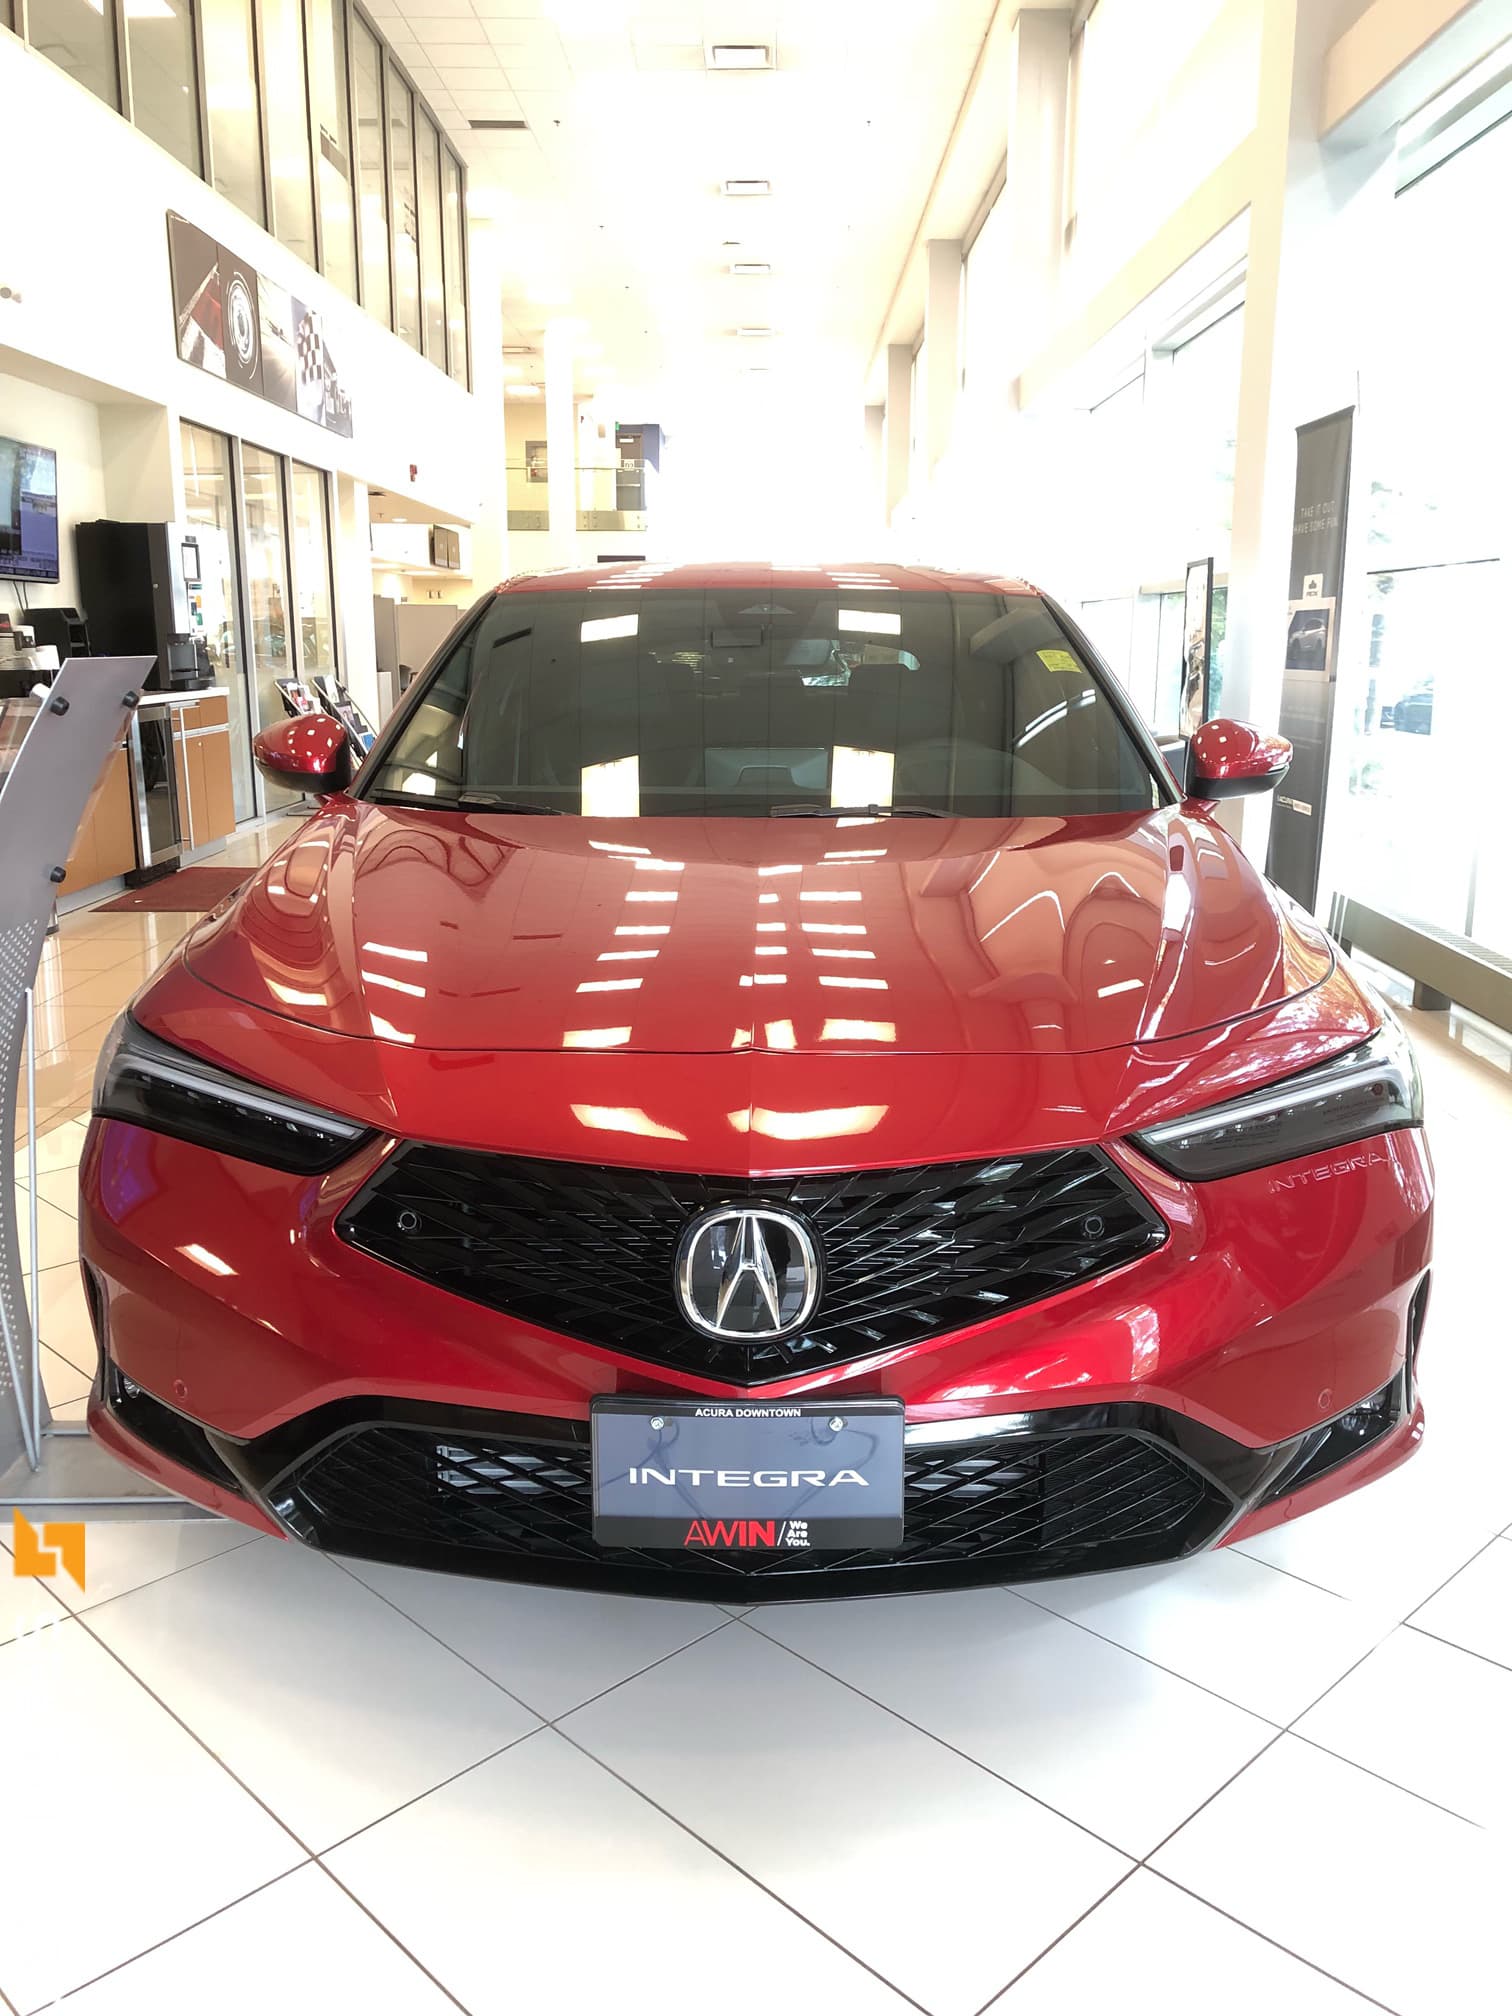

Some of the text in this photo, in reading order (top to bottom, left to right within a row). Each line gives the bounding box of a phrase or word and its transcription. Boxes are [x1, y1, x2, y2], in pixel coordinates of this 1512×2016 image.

[1268, 1152, 1389, 1194] INTEGRA
[695, 1408, 802, 1417] ACURA DOWNTOWN
[629, 1467, 870, 1488] INTEGRA
[789, 1521, 809, 1530] We
[684, 1520, 775, 1547] AWIN
[787, 1530, 808, 1538] Are
[785, 1538, 811, 1547] You.
